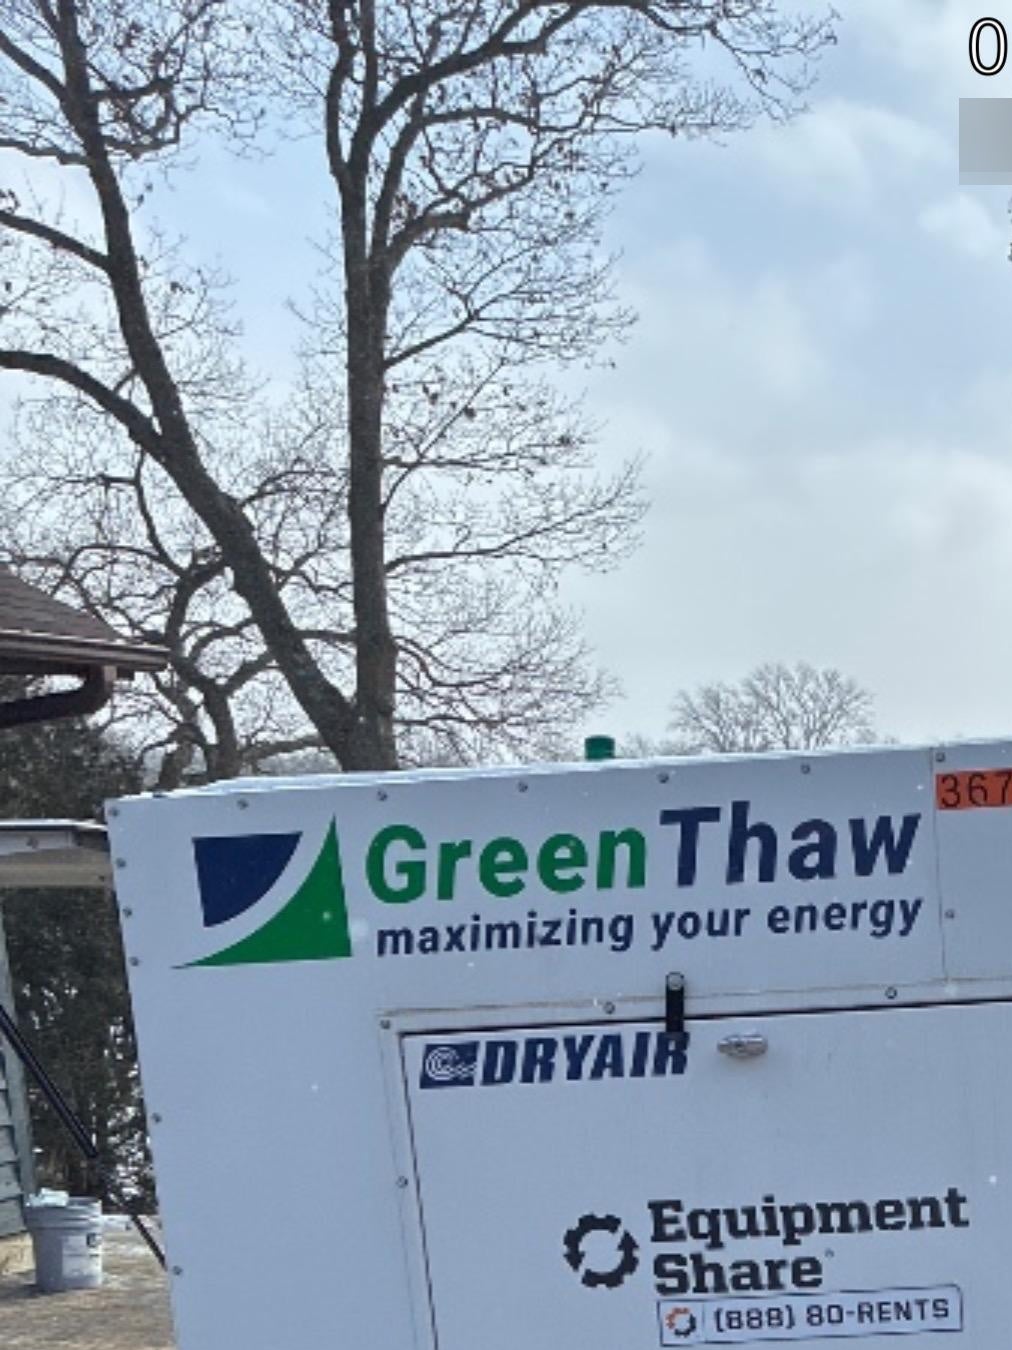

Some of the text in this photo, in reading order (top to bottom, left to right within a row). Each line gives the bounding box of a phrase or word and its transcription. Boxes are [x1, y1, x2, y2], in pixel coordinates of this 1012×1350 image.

[376, 897, 924, 958] maximizing your energy
[480, 1031, 690, 1086] DRYAIR
[647, 1187, 970, 1251] Equipment
[652, 1252, 824, 1297] Share
[713, 1298, 950, 1333] (888) 80-RENTS
